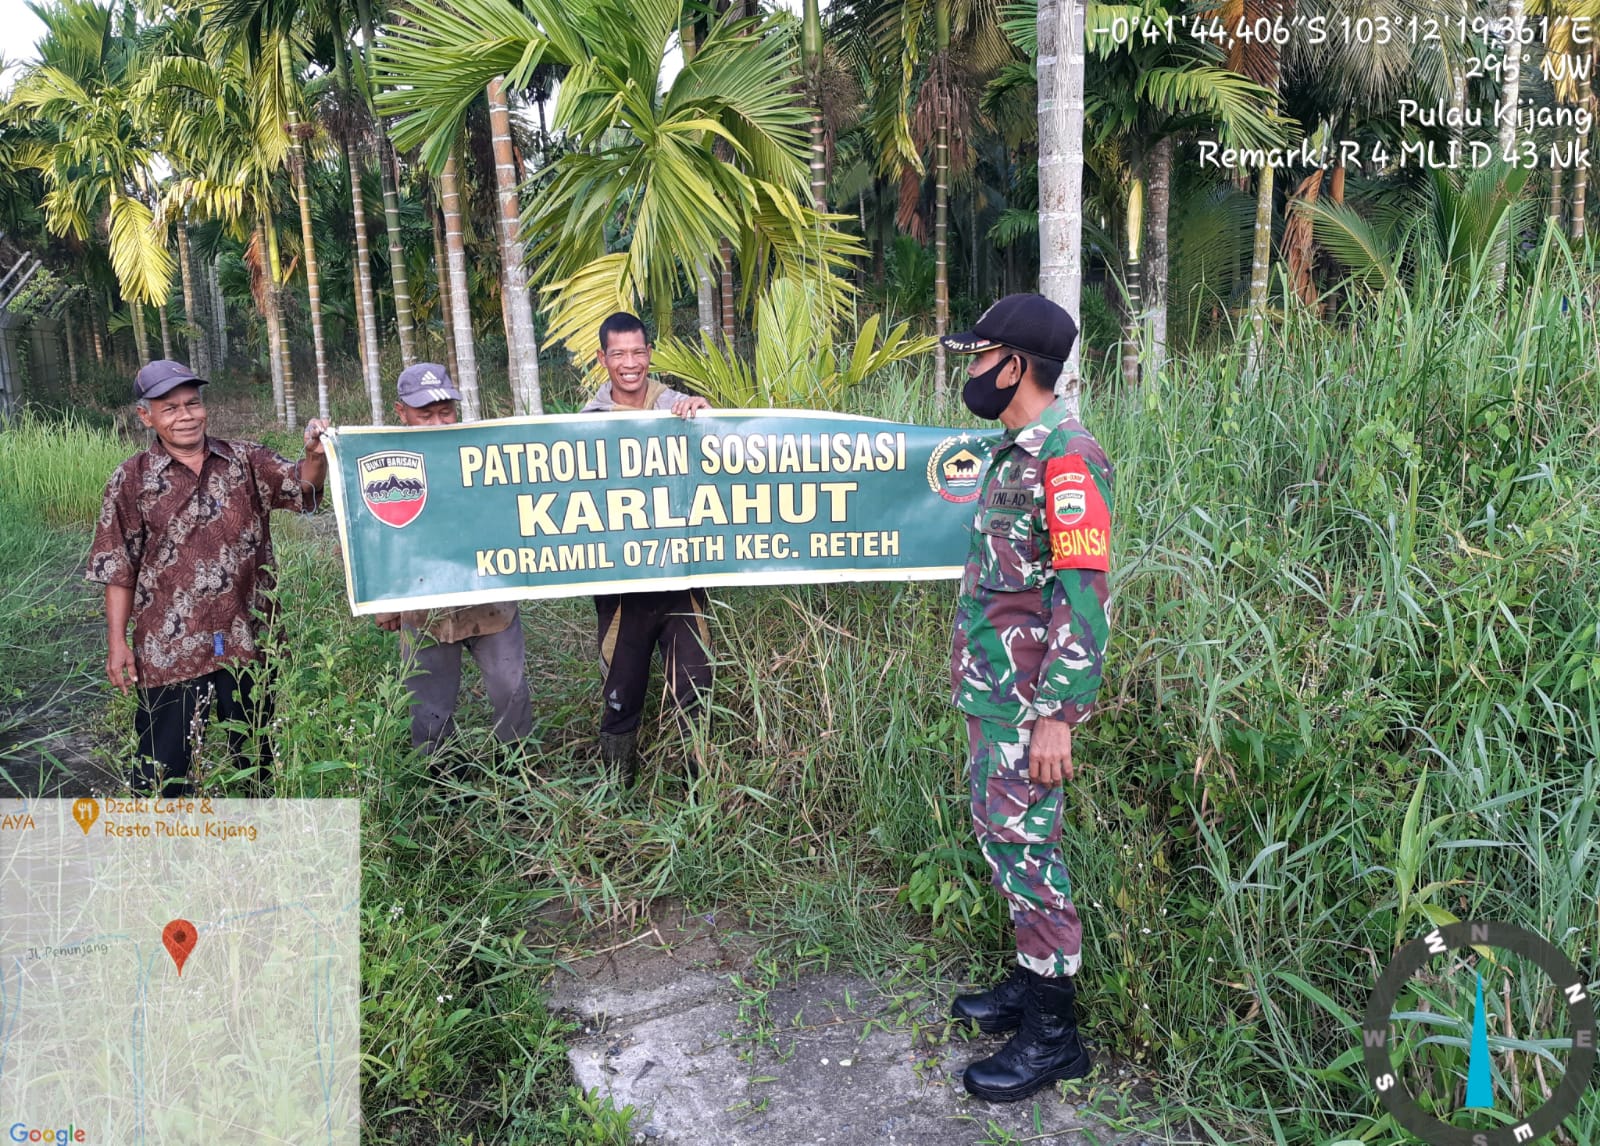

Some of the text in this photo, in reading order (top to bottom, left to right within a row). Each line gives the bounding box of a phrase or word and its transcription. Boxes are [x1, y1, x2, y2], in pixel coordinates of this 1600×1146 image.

[364, 456, 419, 472] BUKIT BARISAN
[458, 431, 906, 488] PATROLI DAN SOSIALISASI
[516, 482, 858, 538] KARLAHUT
[992, 492, 1026, 506] TNI-AD
[475, 530, 899, 577] KORAMIL 07/RTH KEC. RETEH
[1051, 528, 1107, 561] ABINSA
